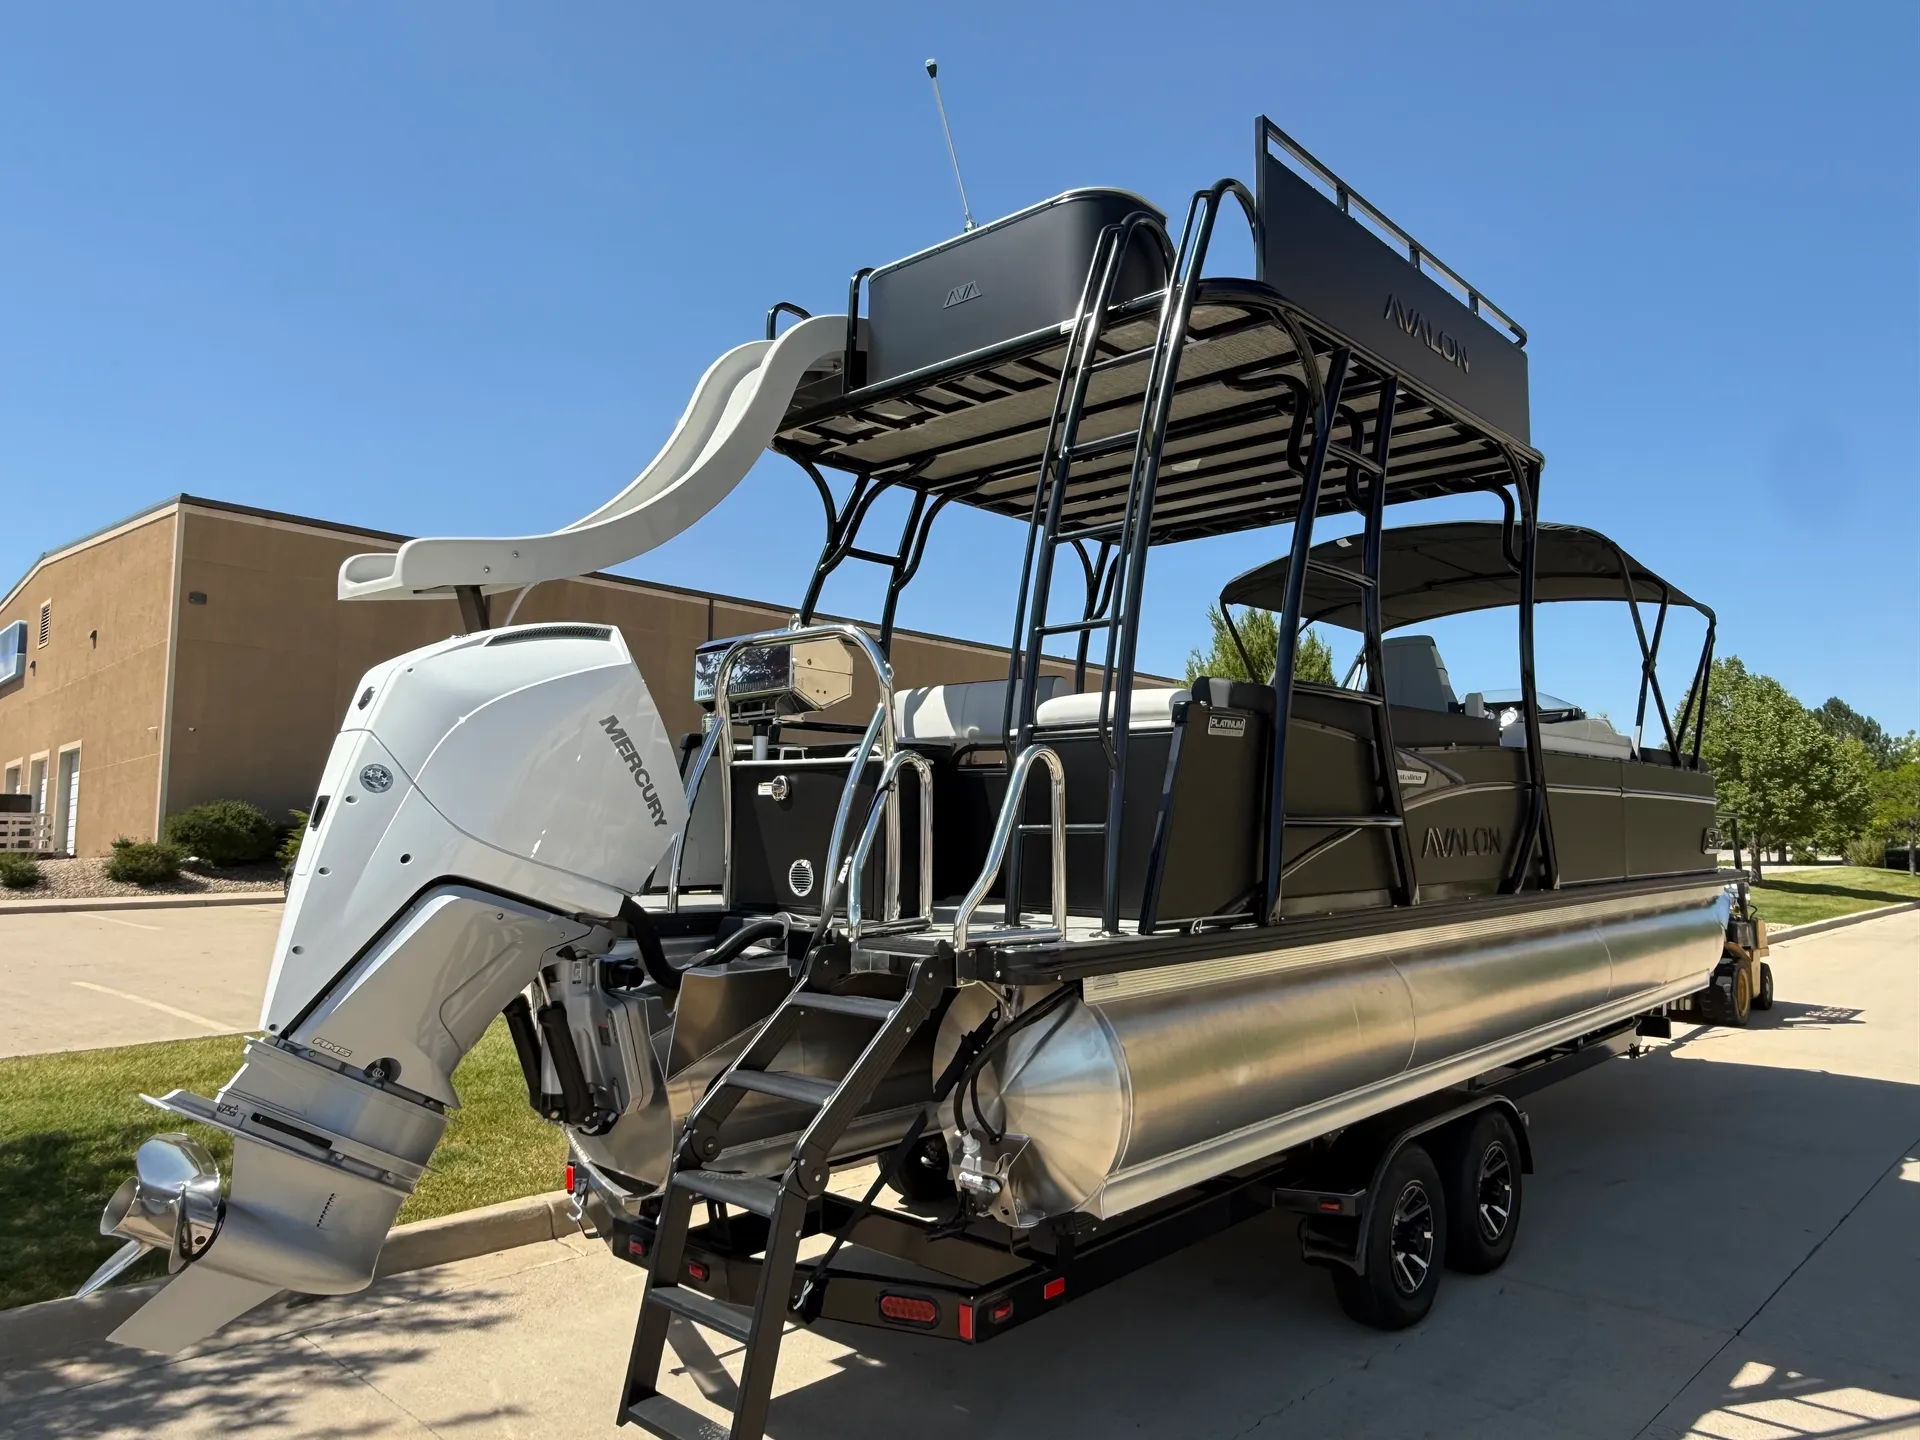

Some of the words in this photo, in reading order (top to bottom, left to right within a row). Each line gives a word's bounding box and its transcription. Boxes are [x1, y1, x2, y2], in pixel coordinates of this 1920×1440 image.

[1383, 293, 1469, 374] AVALON
[1210, 718, 1244, 729] PLATINUM
[599, 715, 667, 827] MERCURY
[1421, 827, 1501, 858] AVALON
